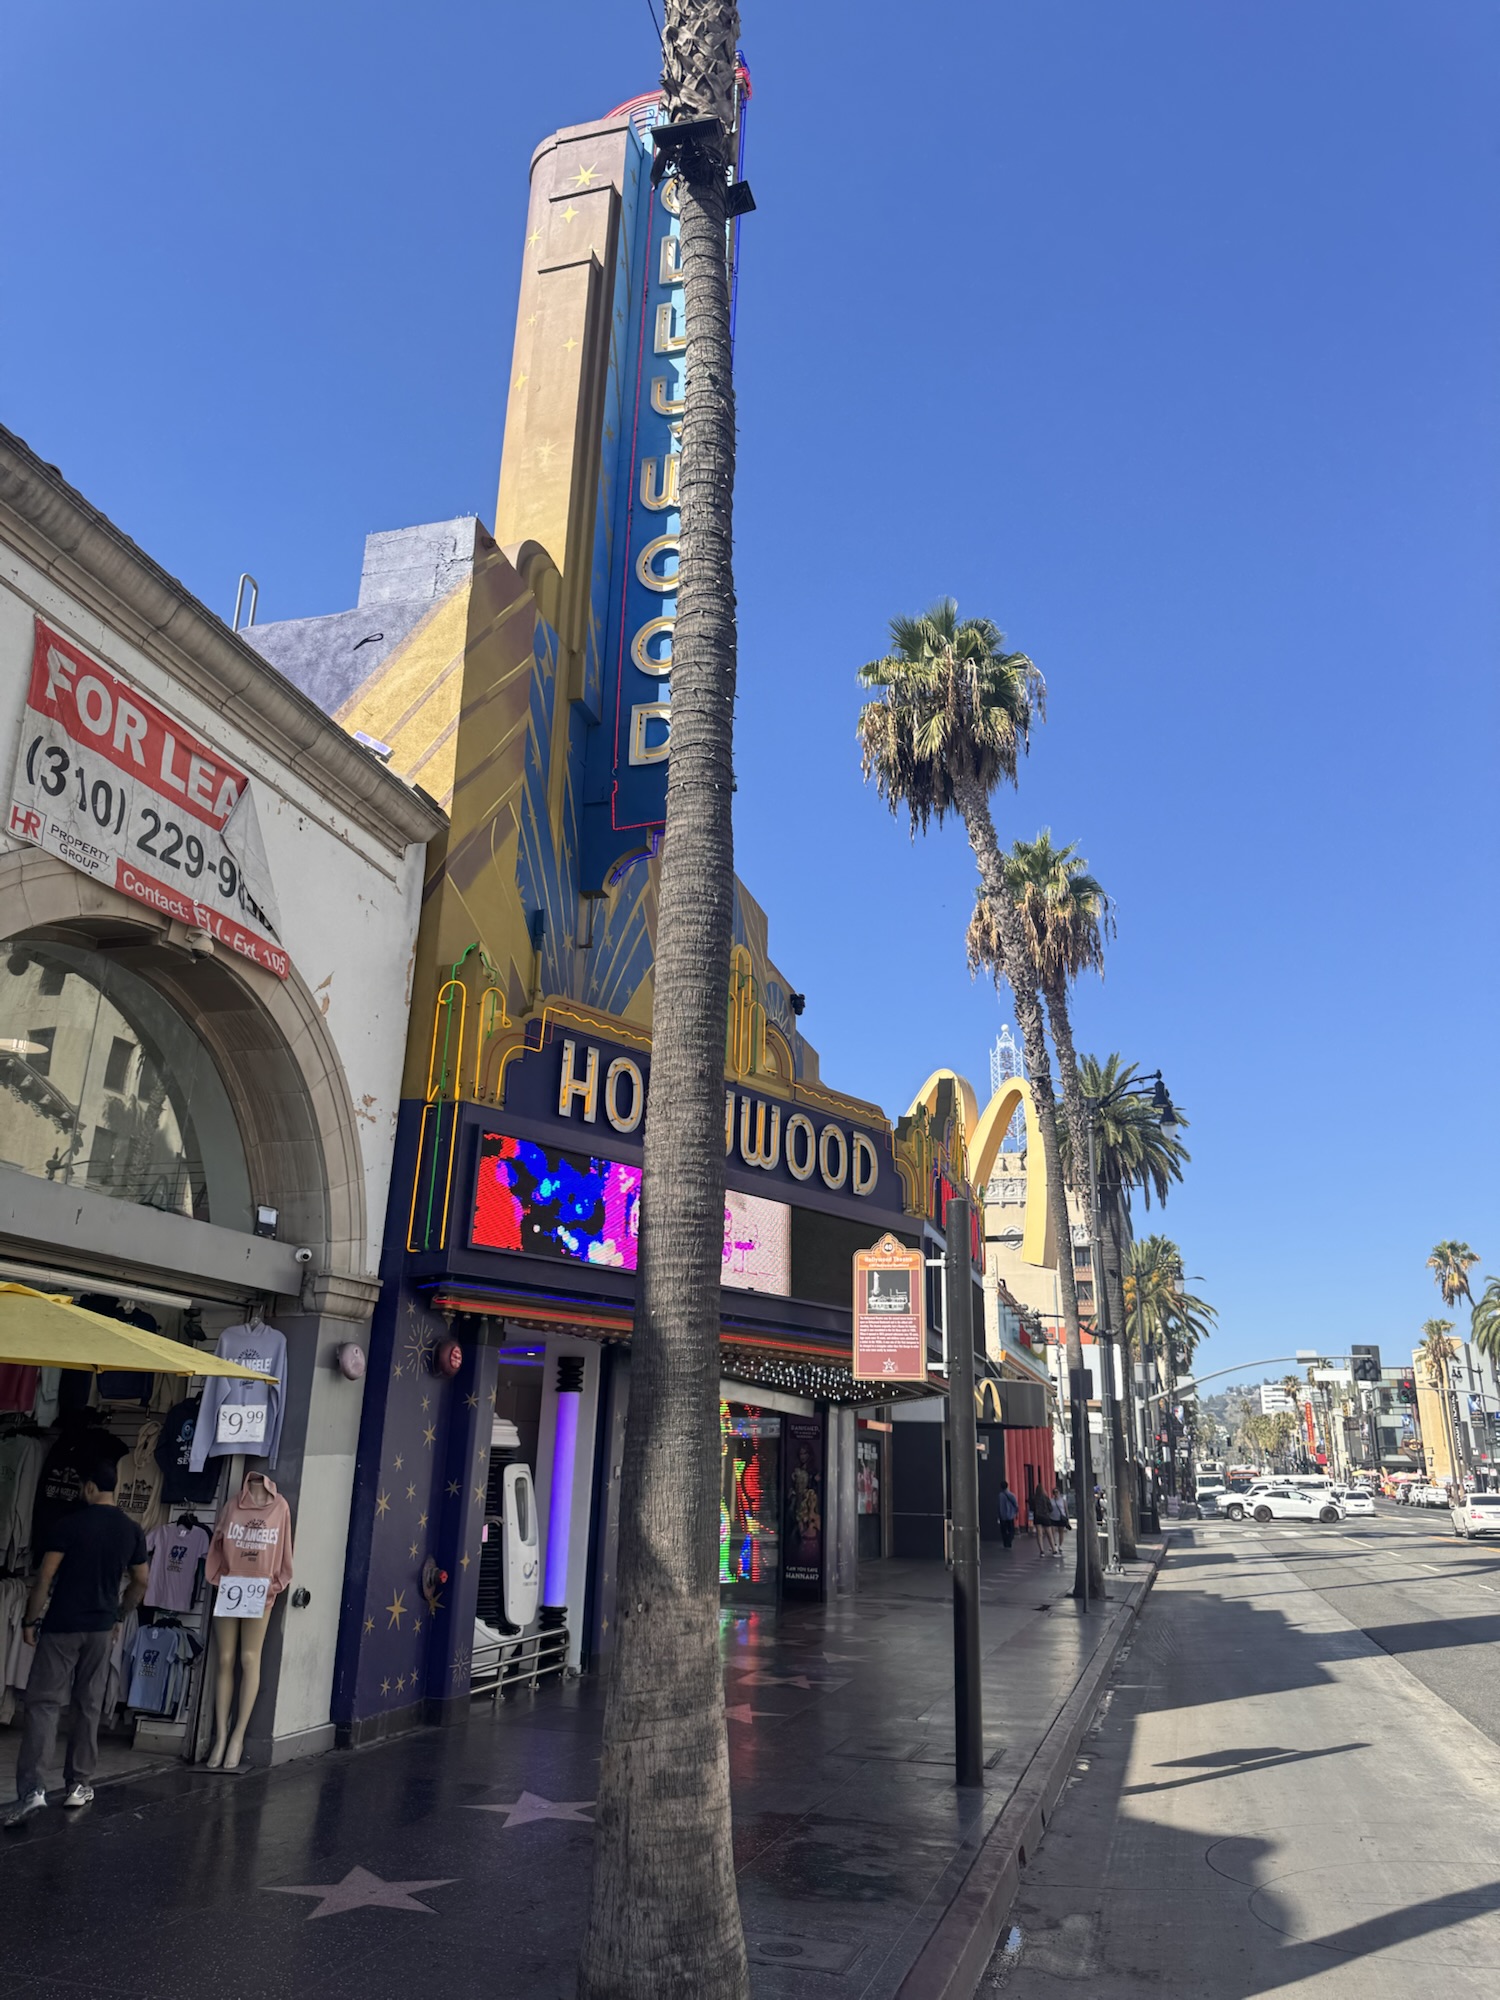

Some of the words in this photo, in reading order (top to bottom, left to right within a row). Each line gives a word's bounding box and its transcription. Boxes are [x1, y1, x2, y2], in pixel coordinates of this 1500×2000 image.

[45, 644, 148, 768] FOR
[26, 735, 126, 835] (310)
[10, 805, 41, 840] HR
[51, 824, 110, 862] PROPERTY
[59, 843, 99, 870] GROUP
[123, 870, 190, 919] Contact:
[233, 932, 261, 962] Ext.
[263, 950, 286, 975] 105
[558, 1039, 878, 1196] HOWOOD
[221, 1410, 264, 1435] $9.99
[227, 1522, 245, 1540] LOS
[244, 1527, 279, 1544] ANGELES
[785, 1572, 819, 1581] HANNAH?
[220, 1583, 266, 1611] $9.99
